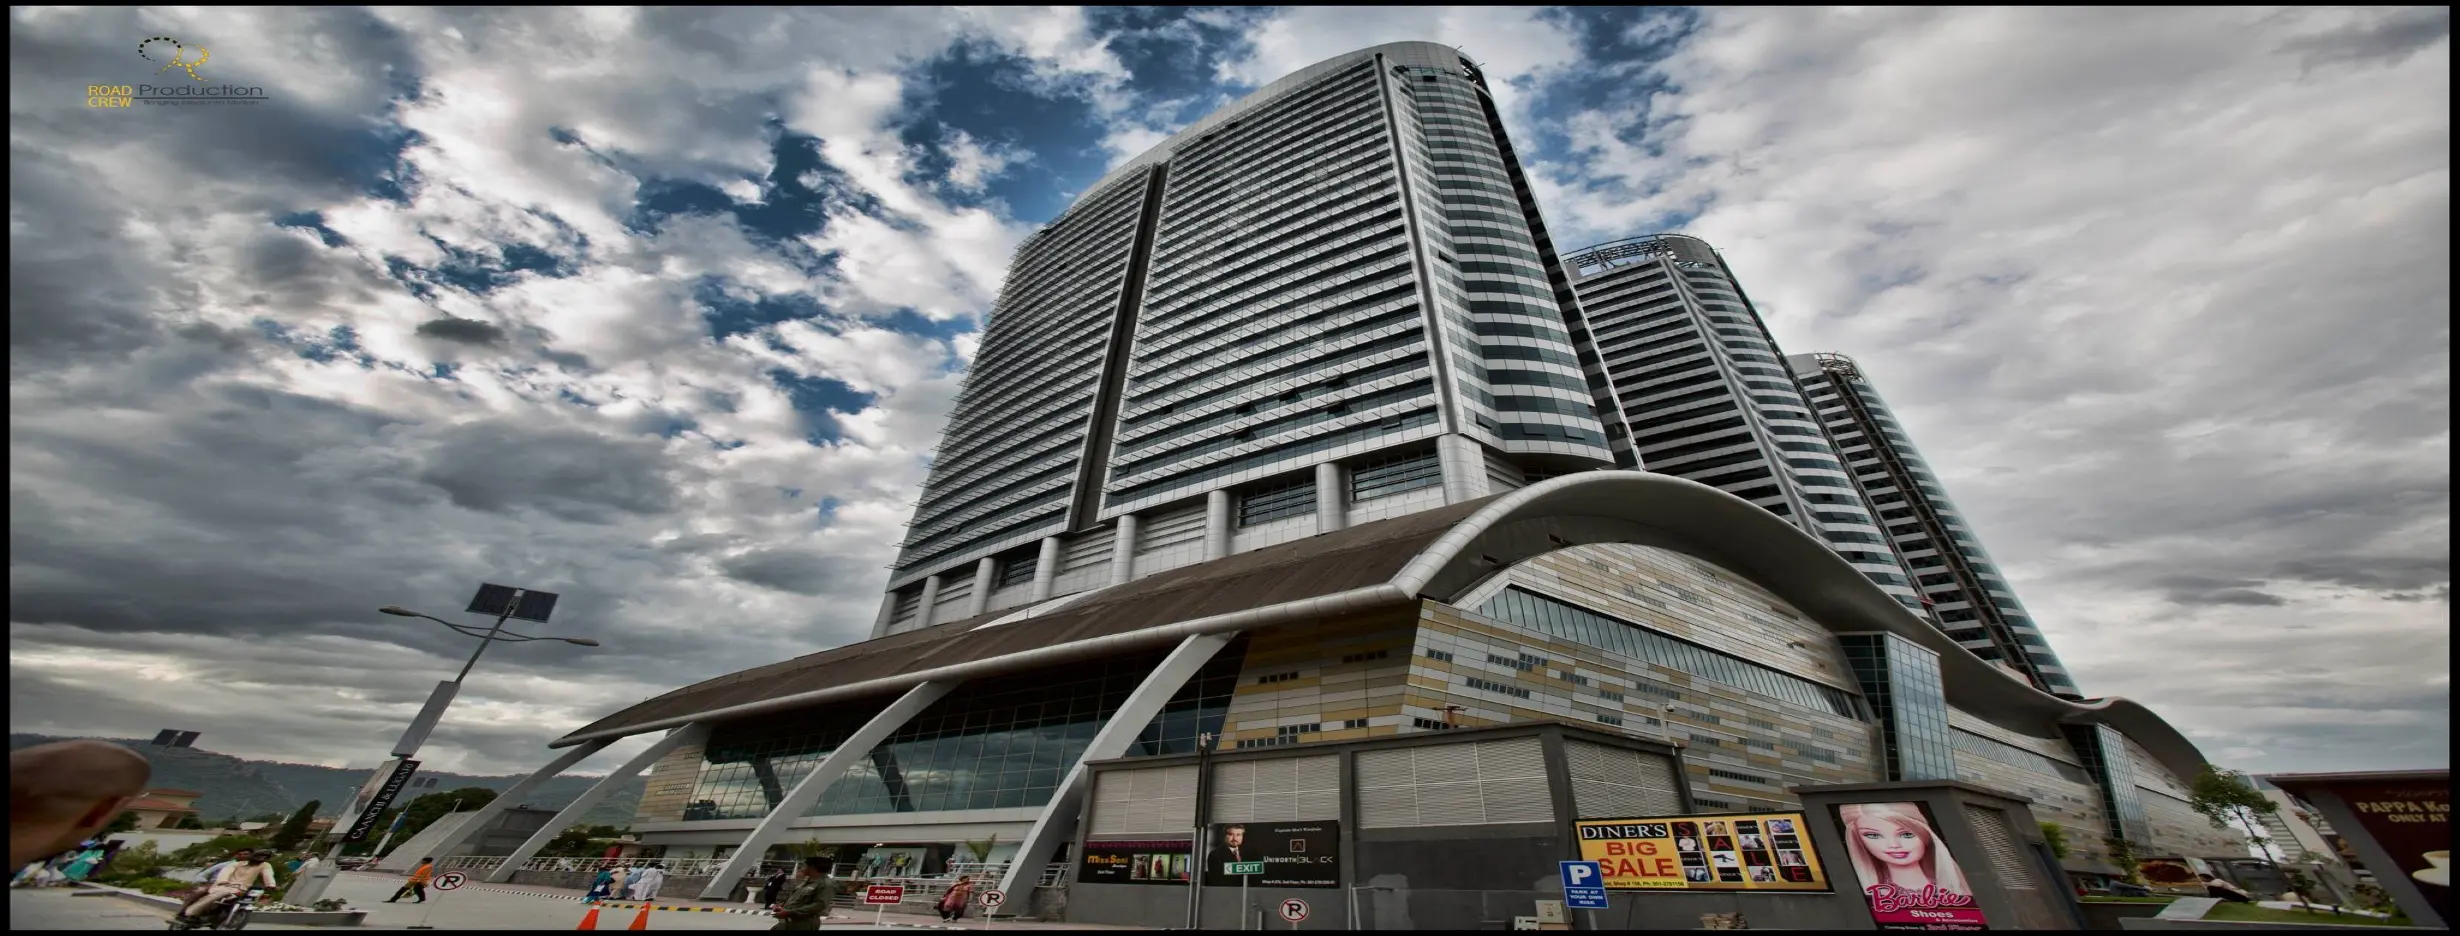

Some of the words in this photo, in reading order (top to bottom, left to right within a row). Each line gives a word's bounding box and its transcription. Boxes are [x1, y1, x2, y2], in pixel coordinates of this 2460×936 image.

[2355, 801, 2423, 813] PAPPA
[2388, 814, 2427, 823] ONLY
[2429, 814, 2448, 822] AT
[1582, 823, 1667, 839] DINER'S
[1606, 841, 1658, 856] BIG
[1236, 863, 1260, 873] EXIT
[1568, 865, 1592, 885] P
[1598, 858, 1678, 877] SALE
[1865, 883, 1973, 912] Barbie
[1910, 909, 1954, 919] Shoes
